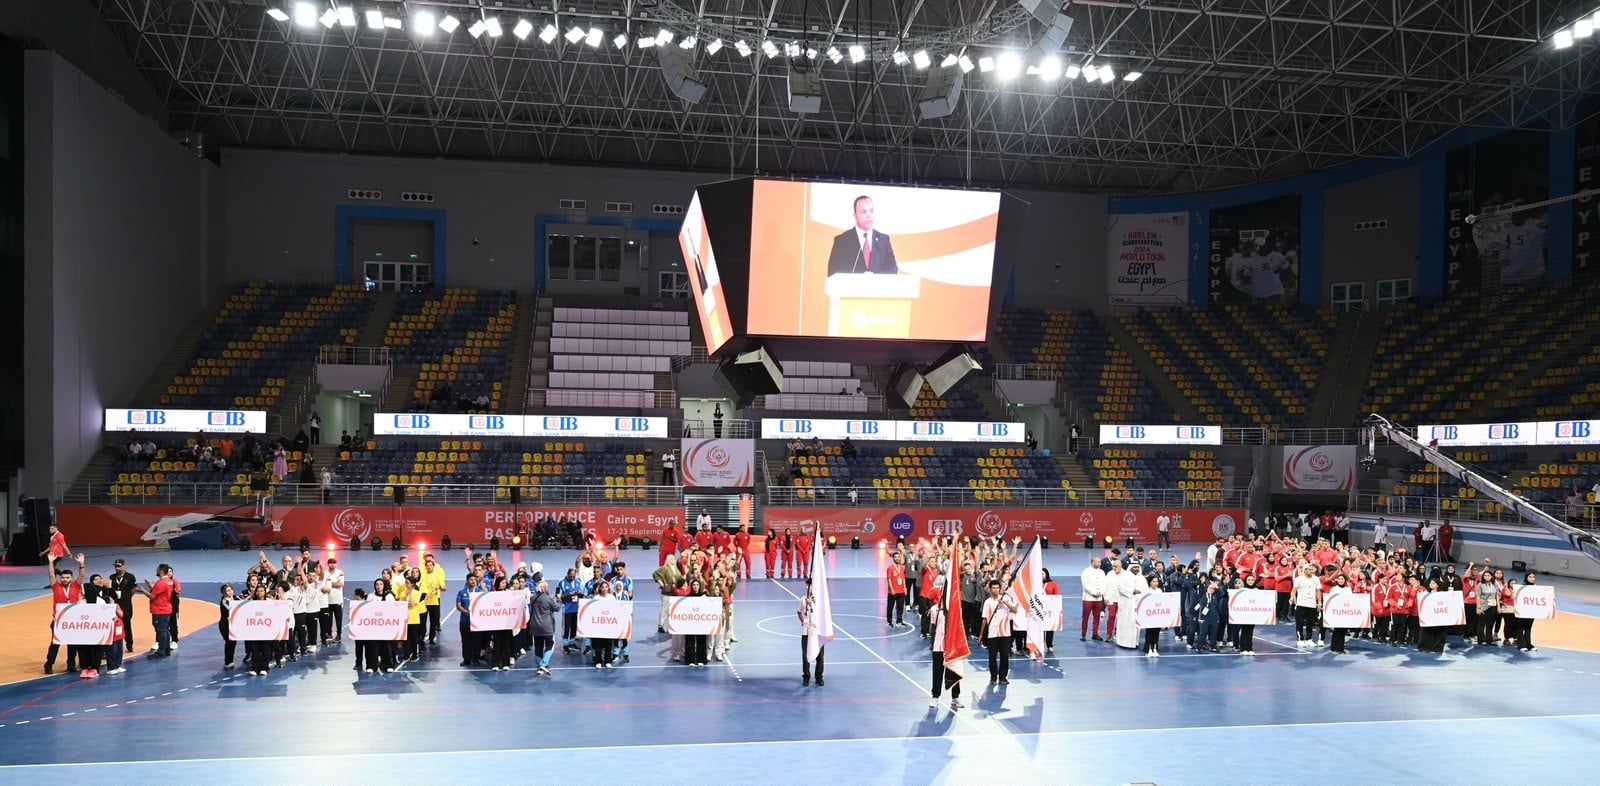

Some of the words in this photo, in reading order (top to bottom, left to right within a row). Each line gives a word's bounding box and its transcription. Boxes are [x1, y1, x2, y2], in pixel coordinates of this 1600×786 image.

[1127, 231, 1157, 240] HARLEM
[1448, 208, 1462, 290] EGYPT
[1127, 262, 1156, 275] EGYPT
[1211, 240, 1223, 302] EGYPT
[127, 410, 166, 425] CIB
[207, 411, 246, 426] CIB
[394, 414, 430, 429] CIB
[469, 415, 505, 430] CIB
[543, 416, 578, 431] CIB
[615, 417, 650, 432] CIB
[779, 419, 812, 433] CIB
[847, 420, 879, 434] CIB
[913, 422, 944, 436] CIB
[977, 423, 1009, 437] CIB
[1116, 426, 1146, 439] CIB
[1176, 426, 1206, 440] CIB
[1431, 425, 1459, 440] CIB
[1488, 423, 1520, 439] CIB
[1555, 421, 1591, 439] CIB
[607, 514, 637, 524] Cairo
[607, 528, 628, 536] 17-23
[631, 528, 664, 537] Septemb
[892, 522, 912, 531] we
[1523, 596, 1547, 607] RYLS
[479, 607, 518, 617] KUWAIT
[1145, 607, 1171, 617] QATAR
[1433, 606, 1449, 614] UAE
[62, 621, 110, 630] BAHRAIN
[246, 618, 272, 627] IRAQ
[357, 618, 400, 626] JORDAN
[591, 616, 618, 625] LIBYA
